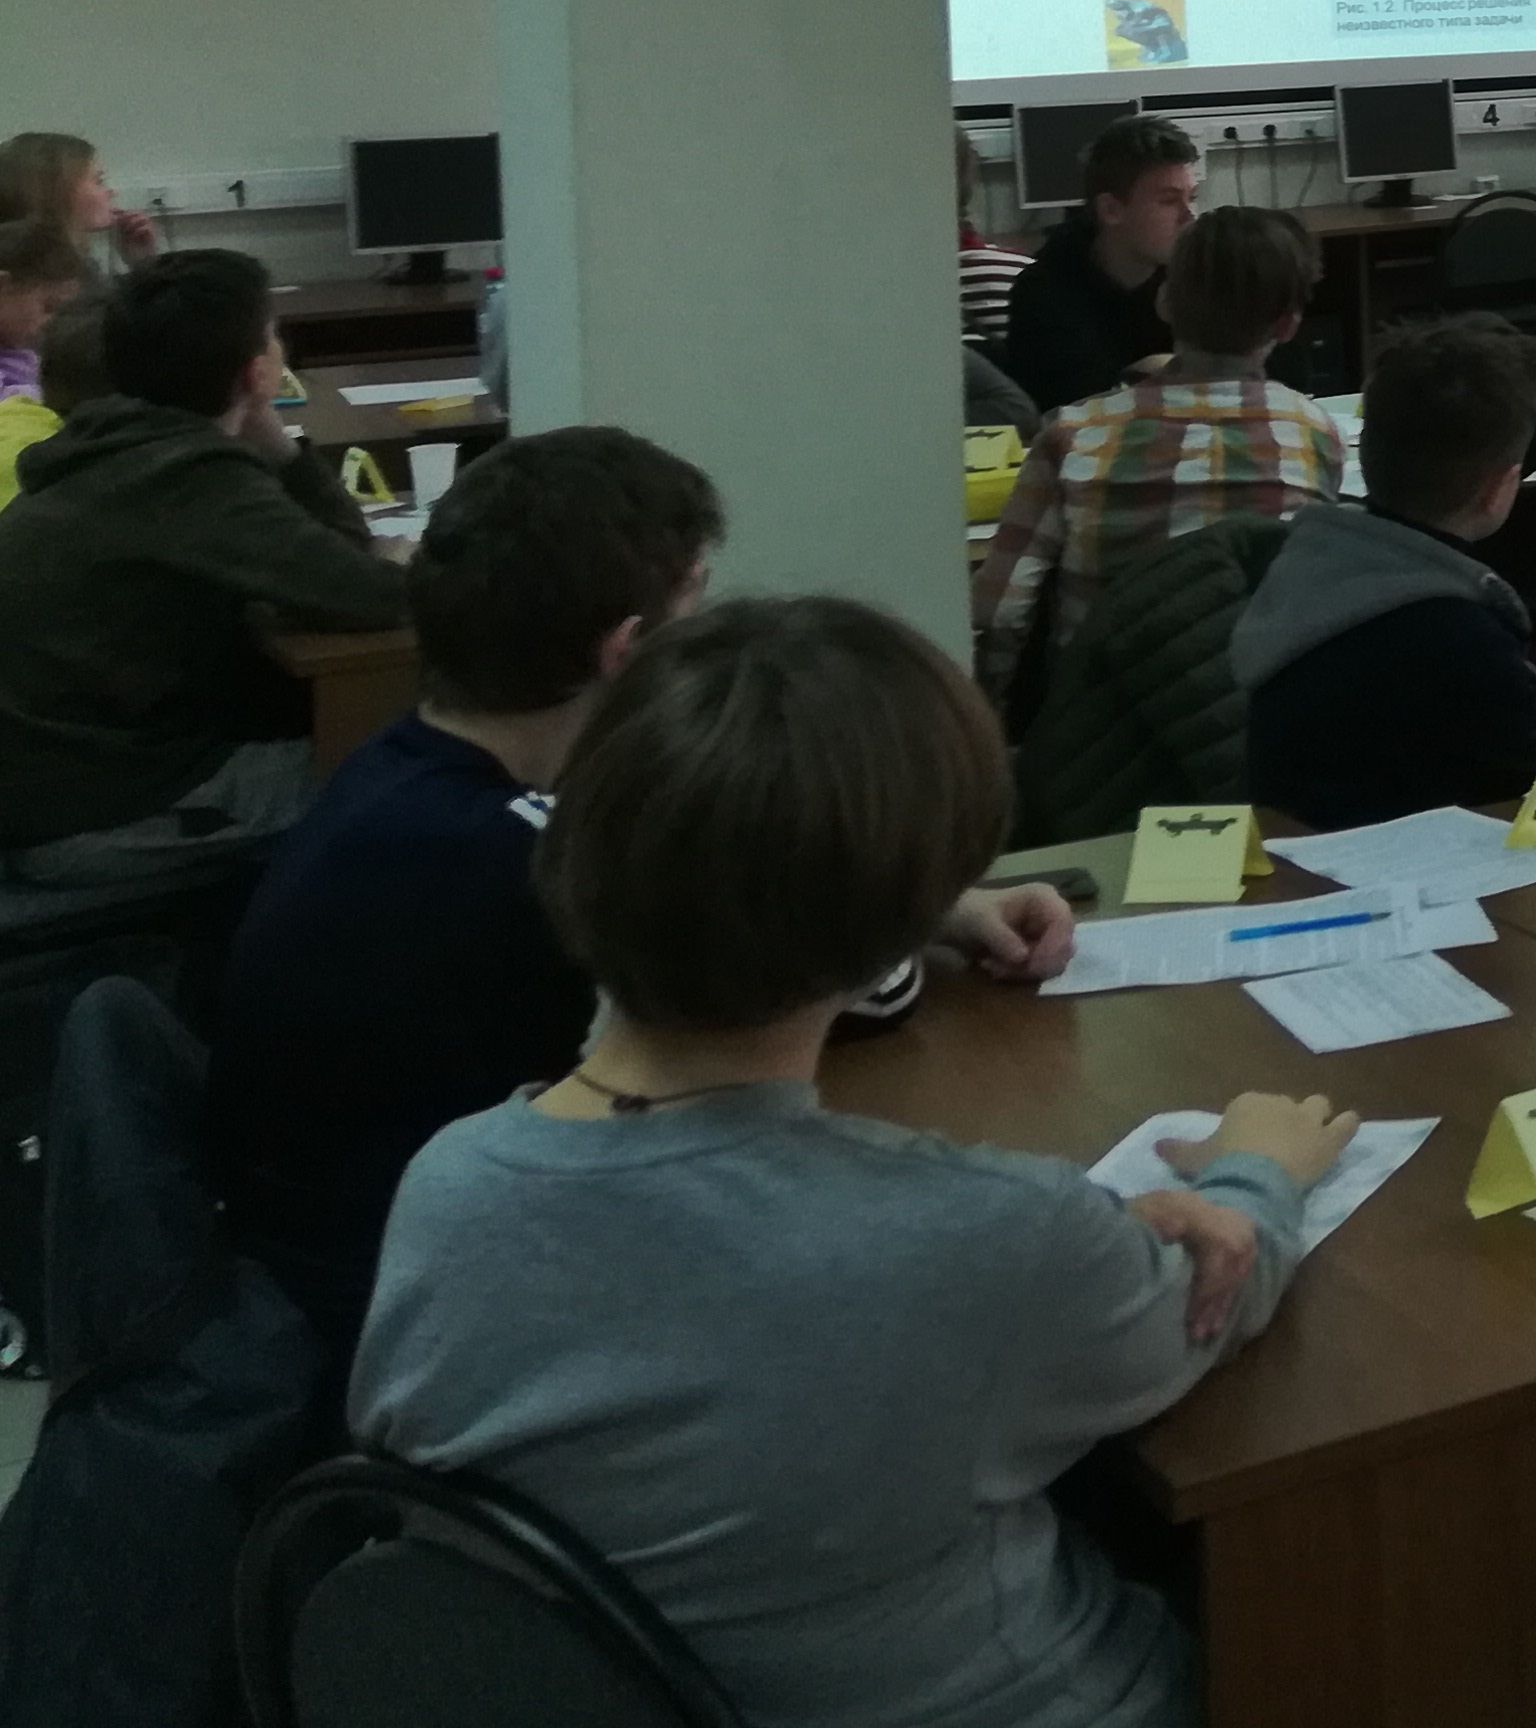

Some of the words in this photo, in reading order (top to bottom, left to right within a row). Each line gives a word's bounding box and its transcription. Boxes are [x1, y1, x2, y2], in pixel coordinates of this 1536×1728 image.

[1336, 16, 1434, 32] неизвестного
[1438, 16, 1471, 28] типа
[1474, 14, 1523, 27] задачи
[1483, 104, 1500, 126] 4
[227, 180, 245, 208] 1
